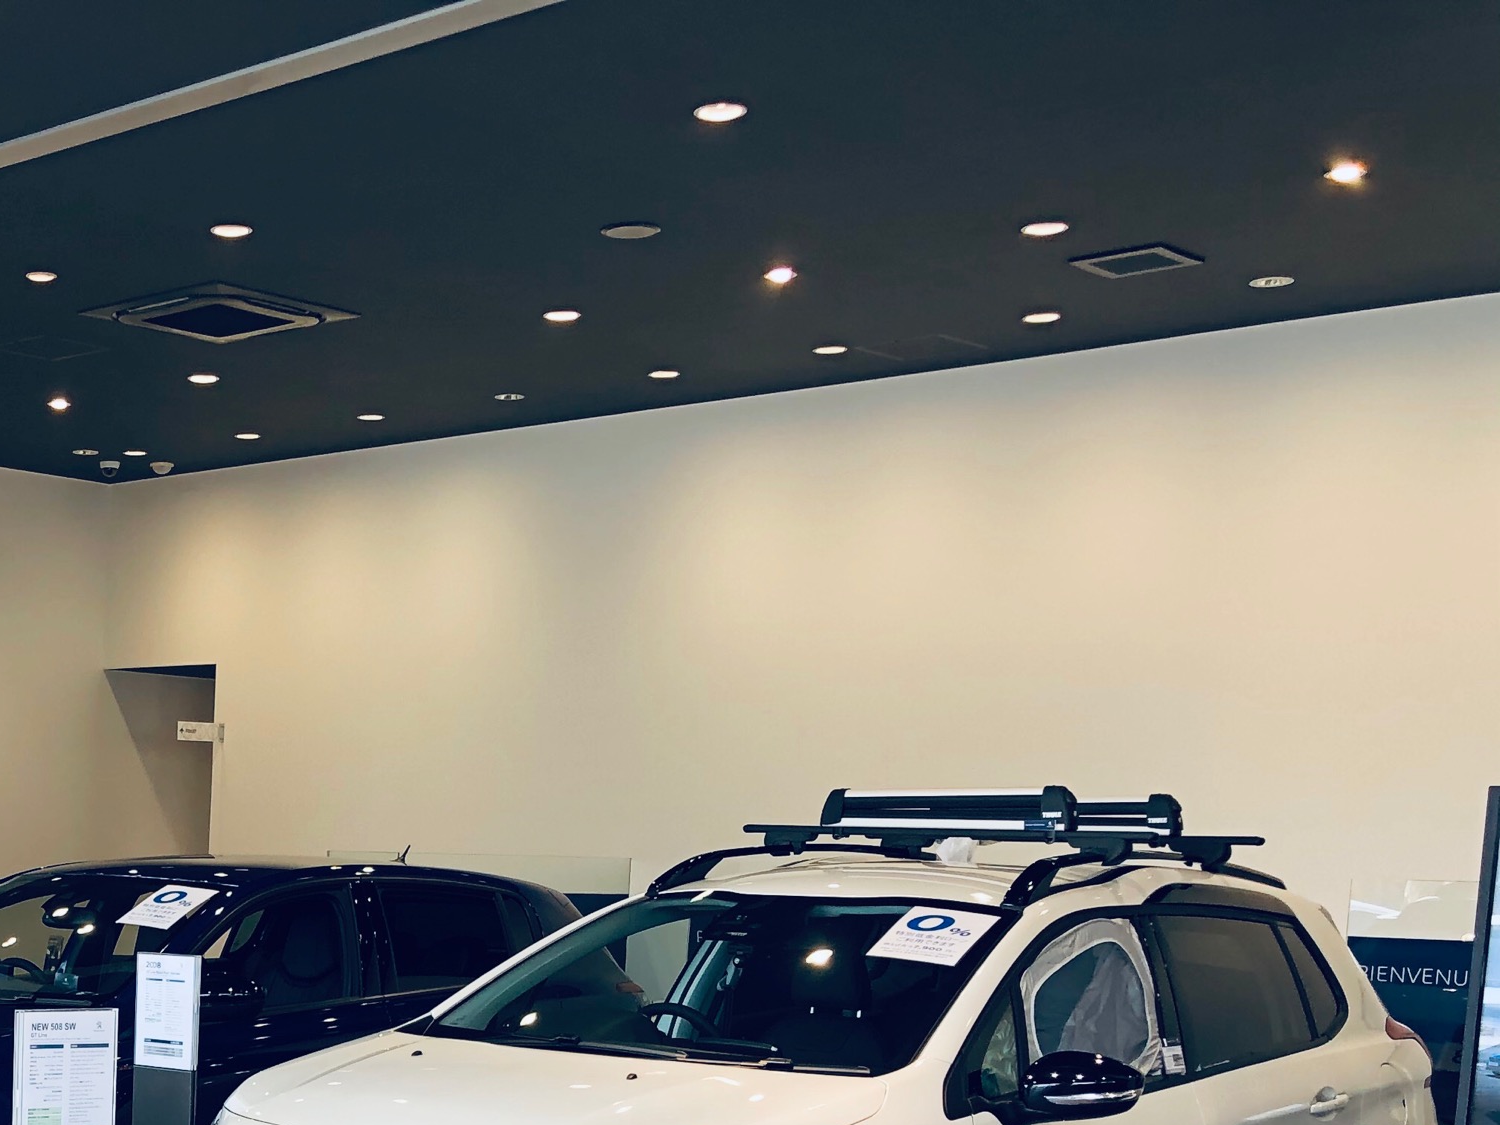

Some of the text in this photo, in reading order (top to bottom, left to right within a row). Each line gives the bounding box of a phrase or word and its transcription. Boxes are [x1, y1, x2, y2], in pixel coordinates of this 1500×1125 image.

[31, 1022, 77, 1031] NEW 508 SW
